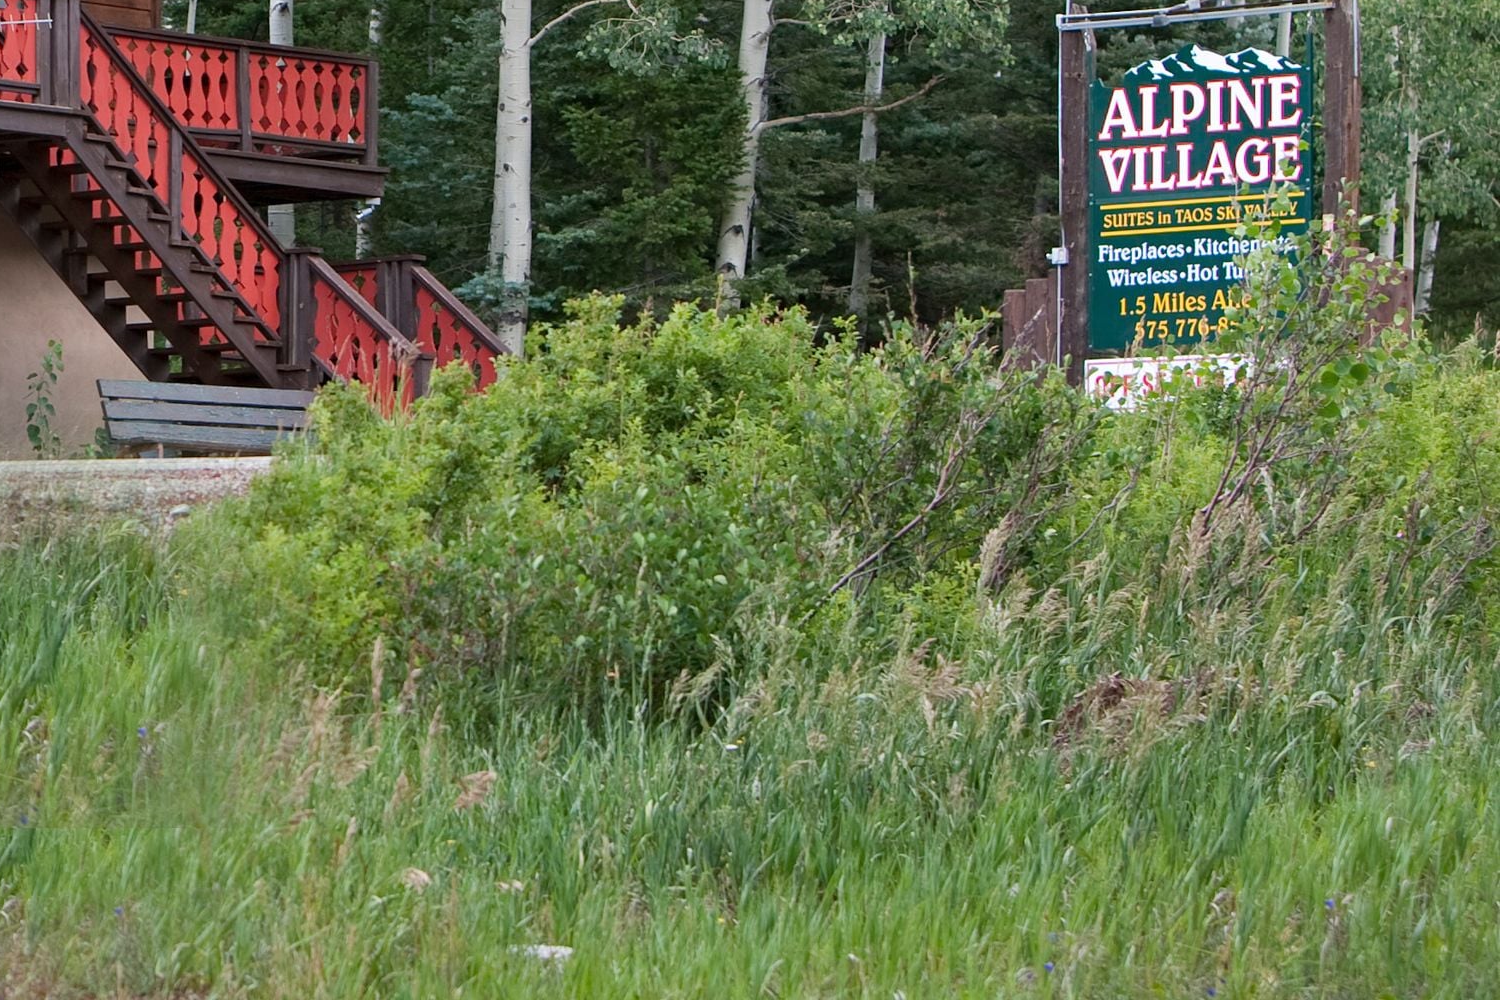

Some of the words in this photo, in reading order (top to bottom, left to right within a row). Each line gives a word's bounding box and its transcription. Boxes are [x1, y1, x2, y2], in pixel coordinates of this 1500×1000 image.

[1098, 73, 1303, 141] ALPINE
[1098, 134, 1303, 193] VILLAGE
[1103, 211, 1154, 228] SUITES
[1158, 211, 1171, 224] in
[1175, 207, 1213, 223] TAOS
[1098, 242, 1185, 264] Fireplaces
[1107, 267, 1178, 287] Wireless
[1186, 264, 1219, 282] Hot
[1222, 261, 1253, 280] Tu
[1120, 296, 1146, 315] 1.5
[1152, 291, 1207, 314] Miles
